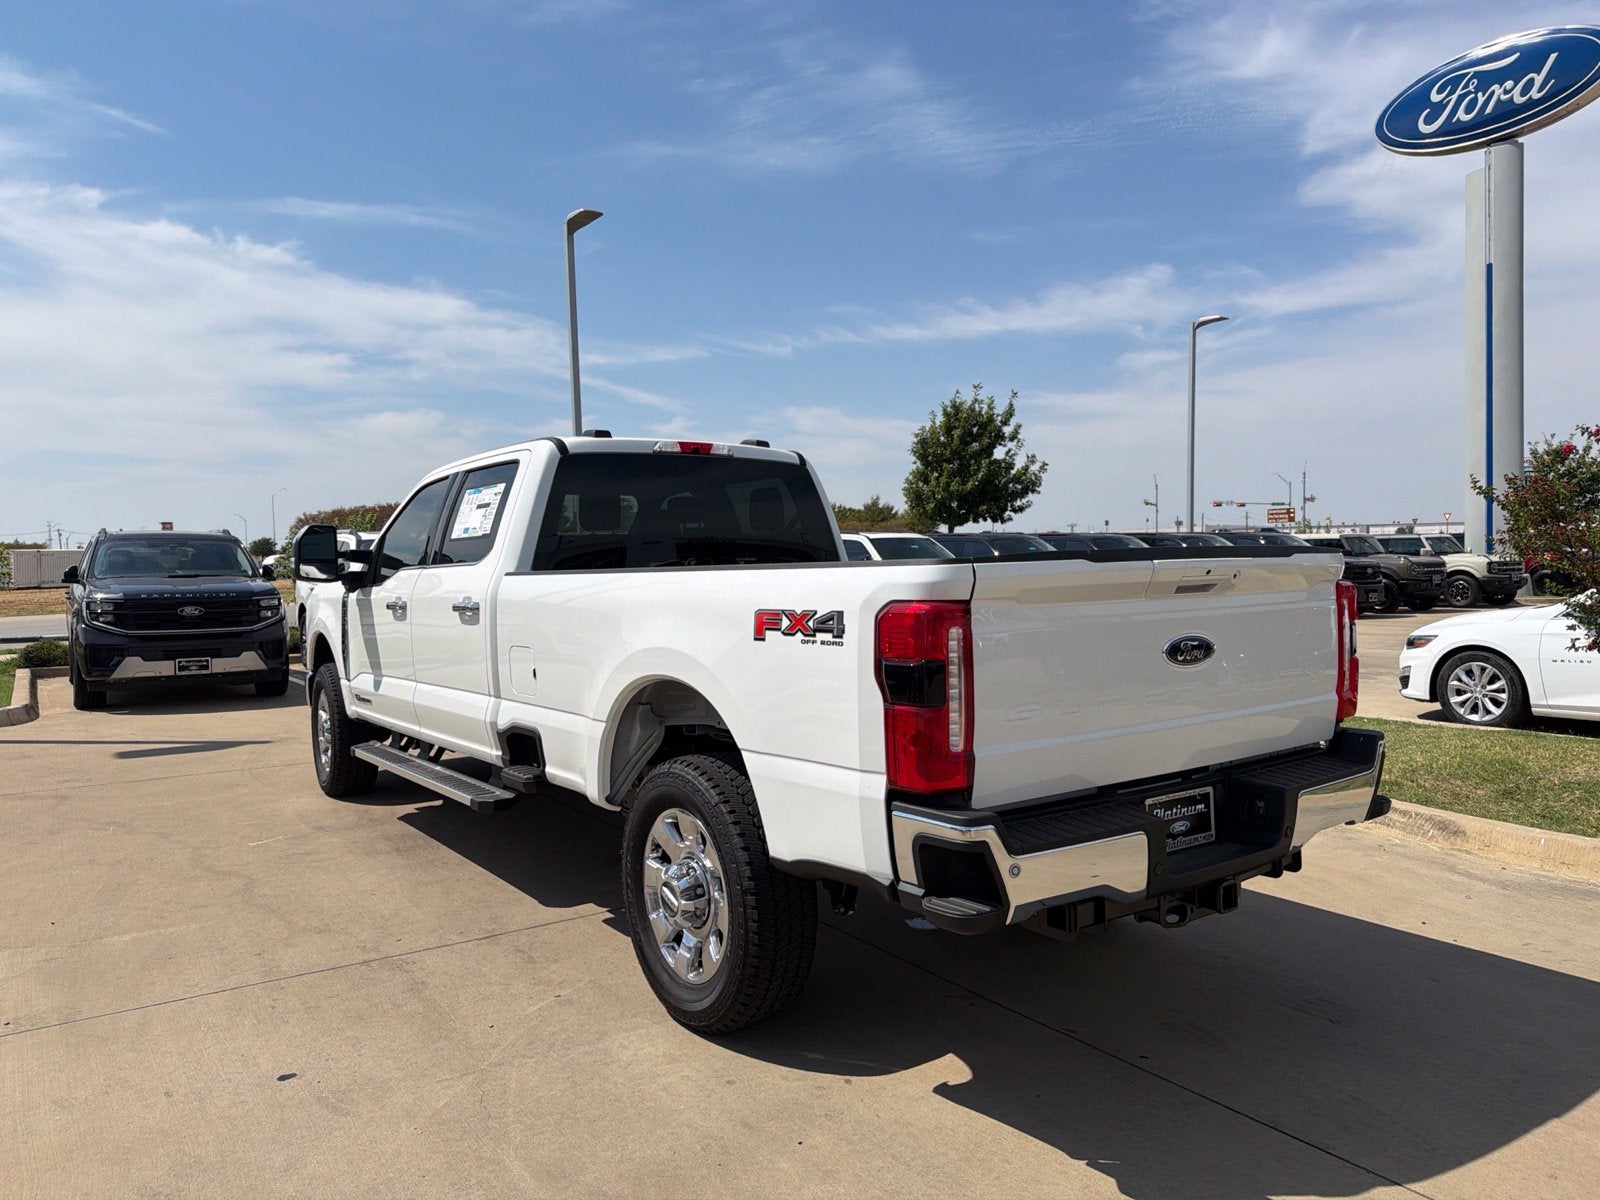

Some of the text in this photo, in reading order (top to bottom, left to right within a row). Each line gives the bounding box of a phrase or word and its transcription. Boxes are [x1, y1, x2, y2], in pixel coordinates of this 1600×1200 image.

[1417, 52, 1559, 134] Ford
[753, 608, 845, 641] FX4
[820, 639, 844, 647] ROAD
[1177, 640, 1205, 661] Ford
[1166, 835, 1203, 851] latinum
